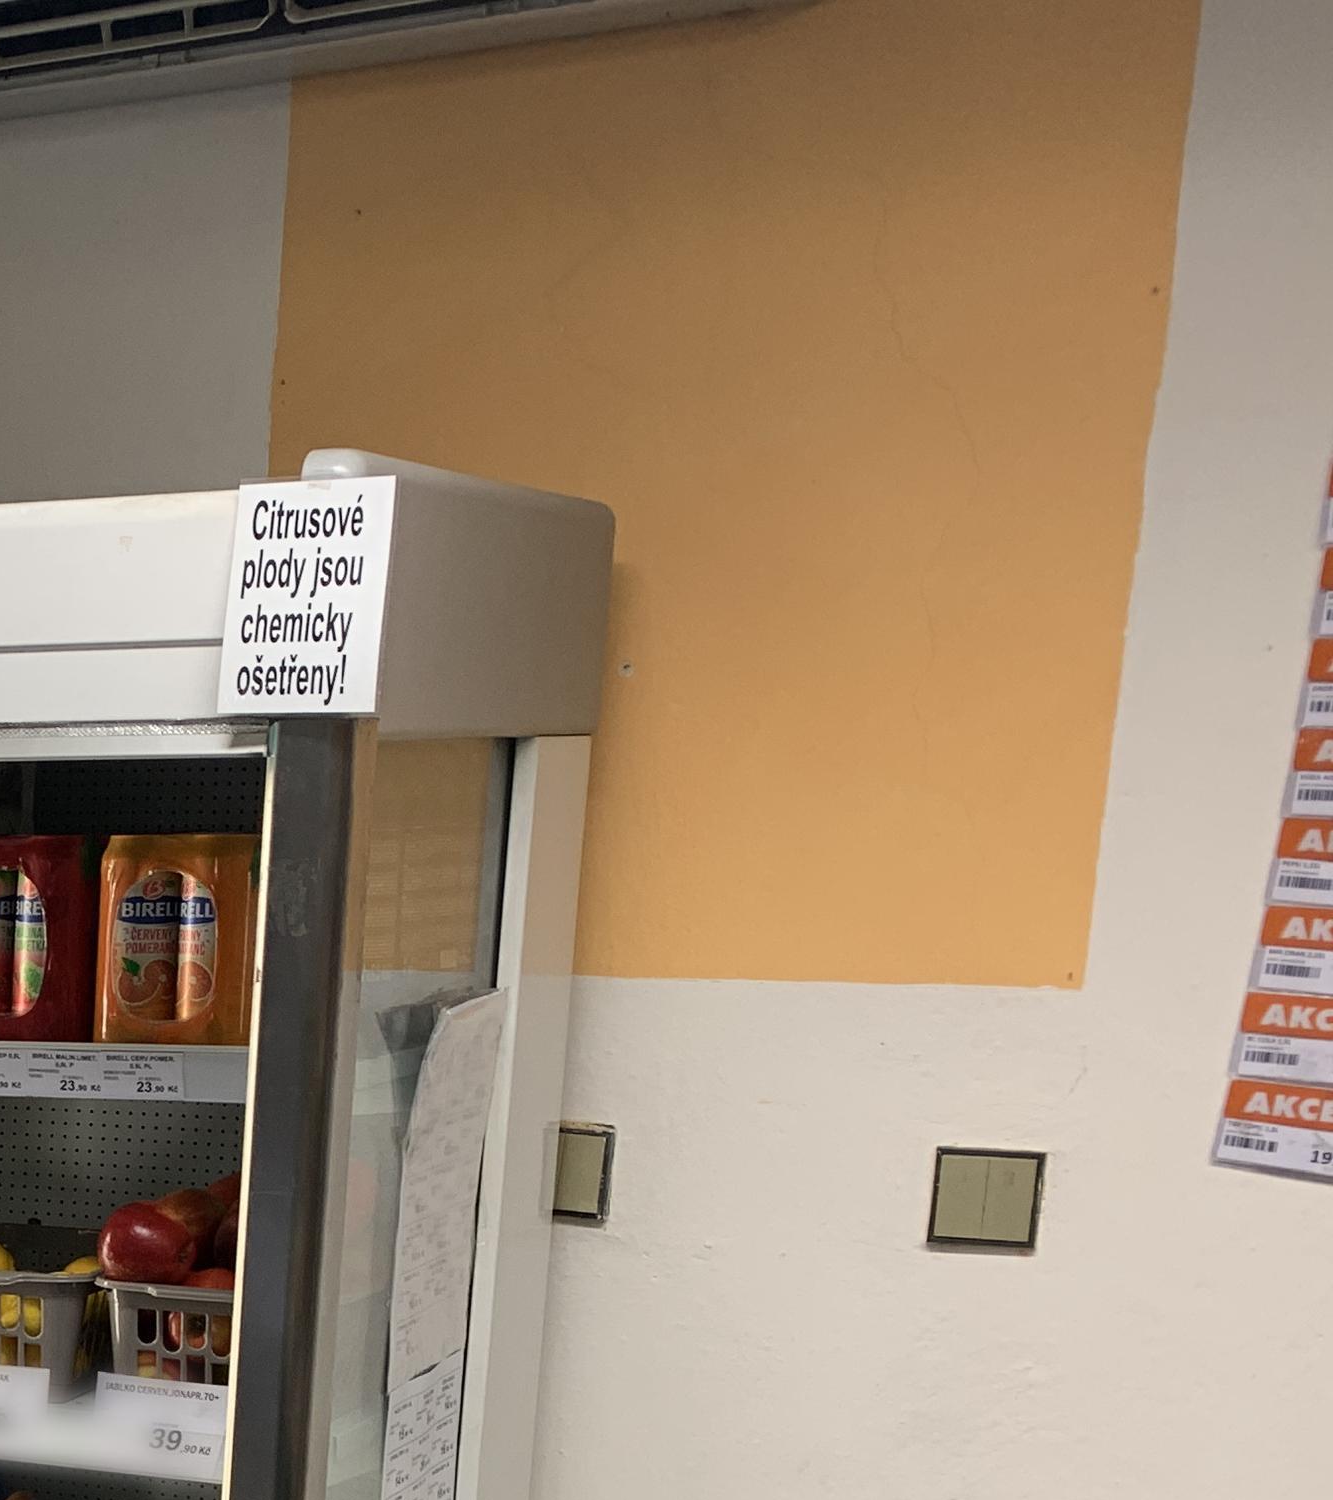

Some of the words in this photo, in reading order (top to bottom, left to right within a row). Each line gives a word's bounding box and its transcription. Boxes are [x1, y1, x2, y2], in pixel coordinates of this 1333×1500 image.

[252, 494, 364, 541] Citrusové
[240, 548, 307, 600] plody
[309, 547, 364, 598] jsou
[240, 603, 352, 653] chemicky
[236, 654, 347, 706] ošetřeny!
[1280, 916, 1333, 941] AK
[1259, 1002, 1333, 1031] AKC
[198, 1445, 212, 1457] Kč
